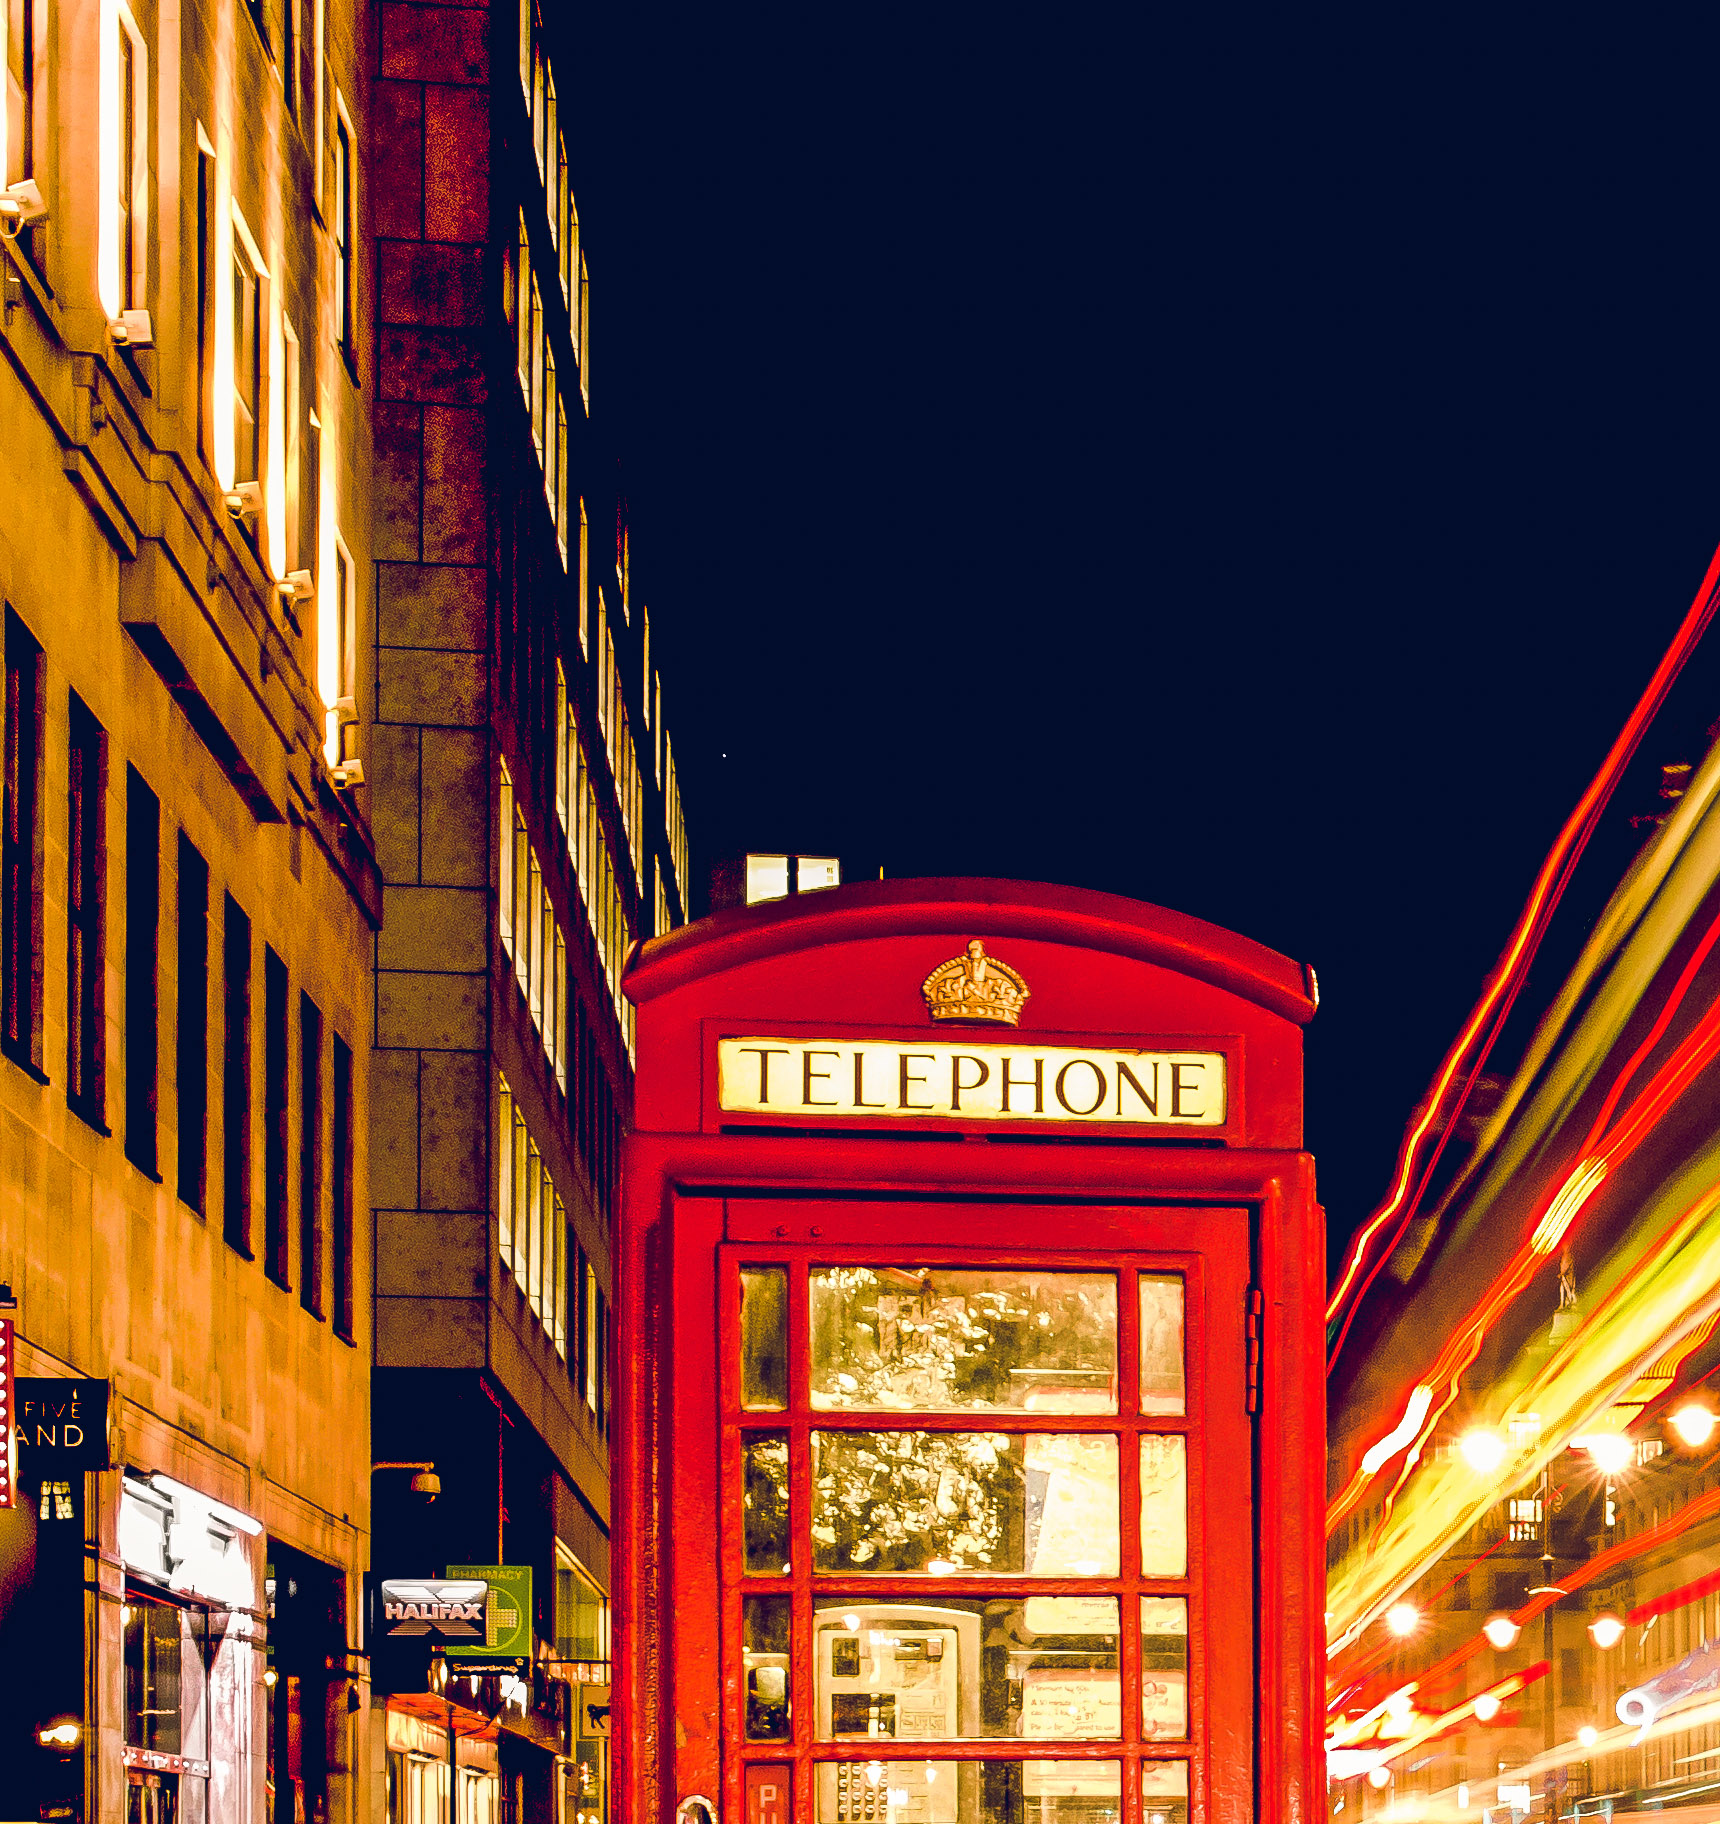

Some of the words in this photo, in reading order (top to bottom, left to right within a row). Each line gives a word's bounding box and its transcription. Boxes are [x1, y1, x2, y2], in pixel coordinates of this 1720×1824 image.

[738, 1047, 1207, 1118] TELEPHONE
[24, 1401, 83, 1419] FIVE
[451, 1569, 524, 1580] PHARMACY
[384, 1602, 483, 1620] HALIFAX
